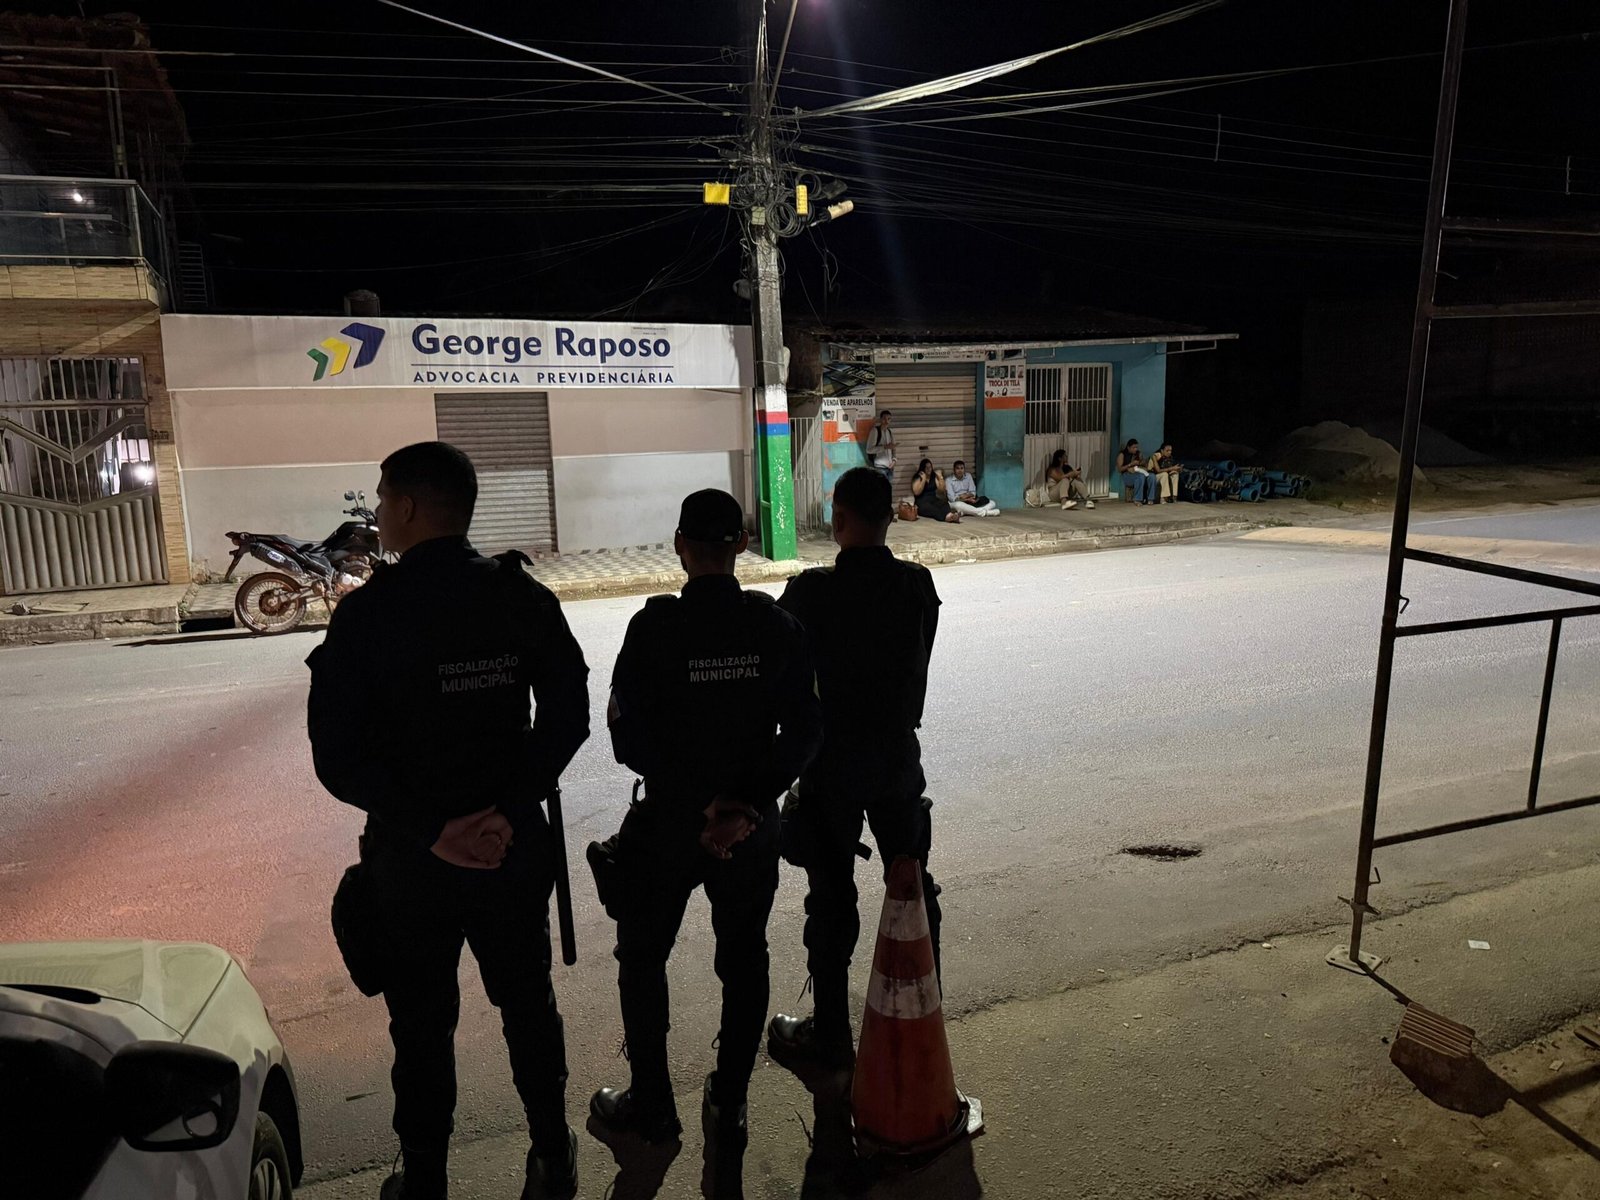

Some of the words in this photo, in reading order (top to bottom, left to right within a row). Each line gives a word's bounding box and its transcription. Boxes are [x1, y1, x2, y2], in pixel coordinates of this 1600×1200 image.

[412, 324, 542, 363] George
[555, 327, 671, 364] Raposo
[413, 371, 520, 383] ADVOCACIA
[537, 369, 674, 384] PREVIDENCIÁRIA
[840, 398, 847, 406] DE
[847, 398, 873, 406] APARELHOS
[438, 654, 519, 676] FISCALIZAÇÃO
[688, 653, 760, 669] FISCALIZAÇÃO
[441, 671, 516, 693] MUNICIPAL
[690, 666, 760, 682] MUNICIPAL
